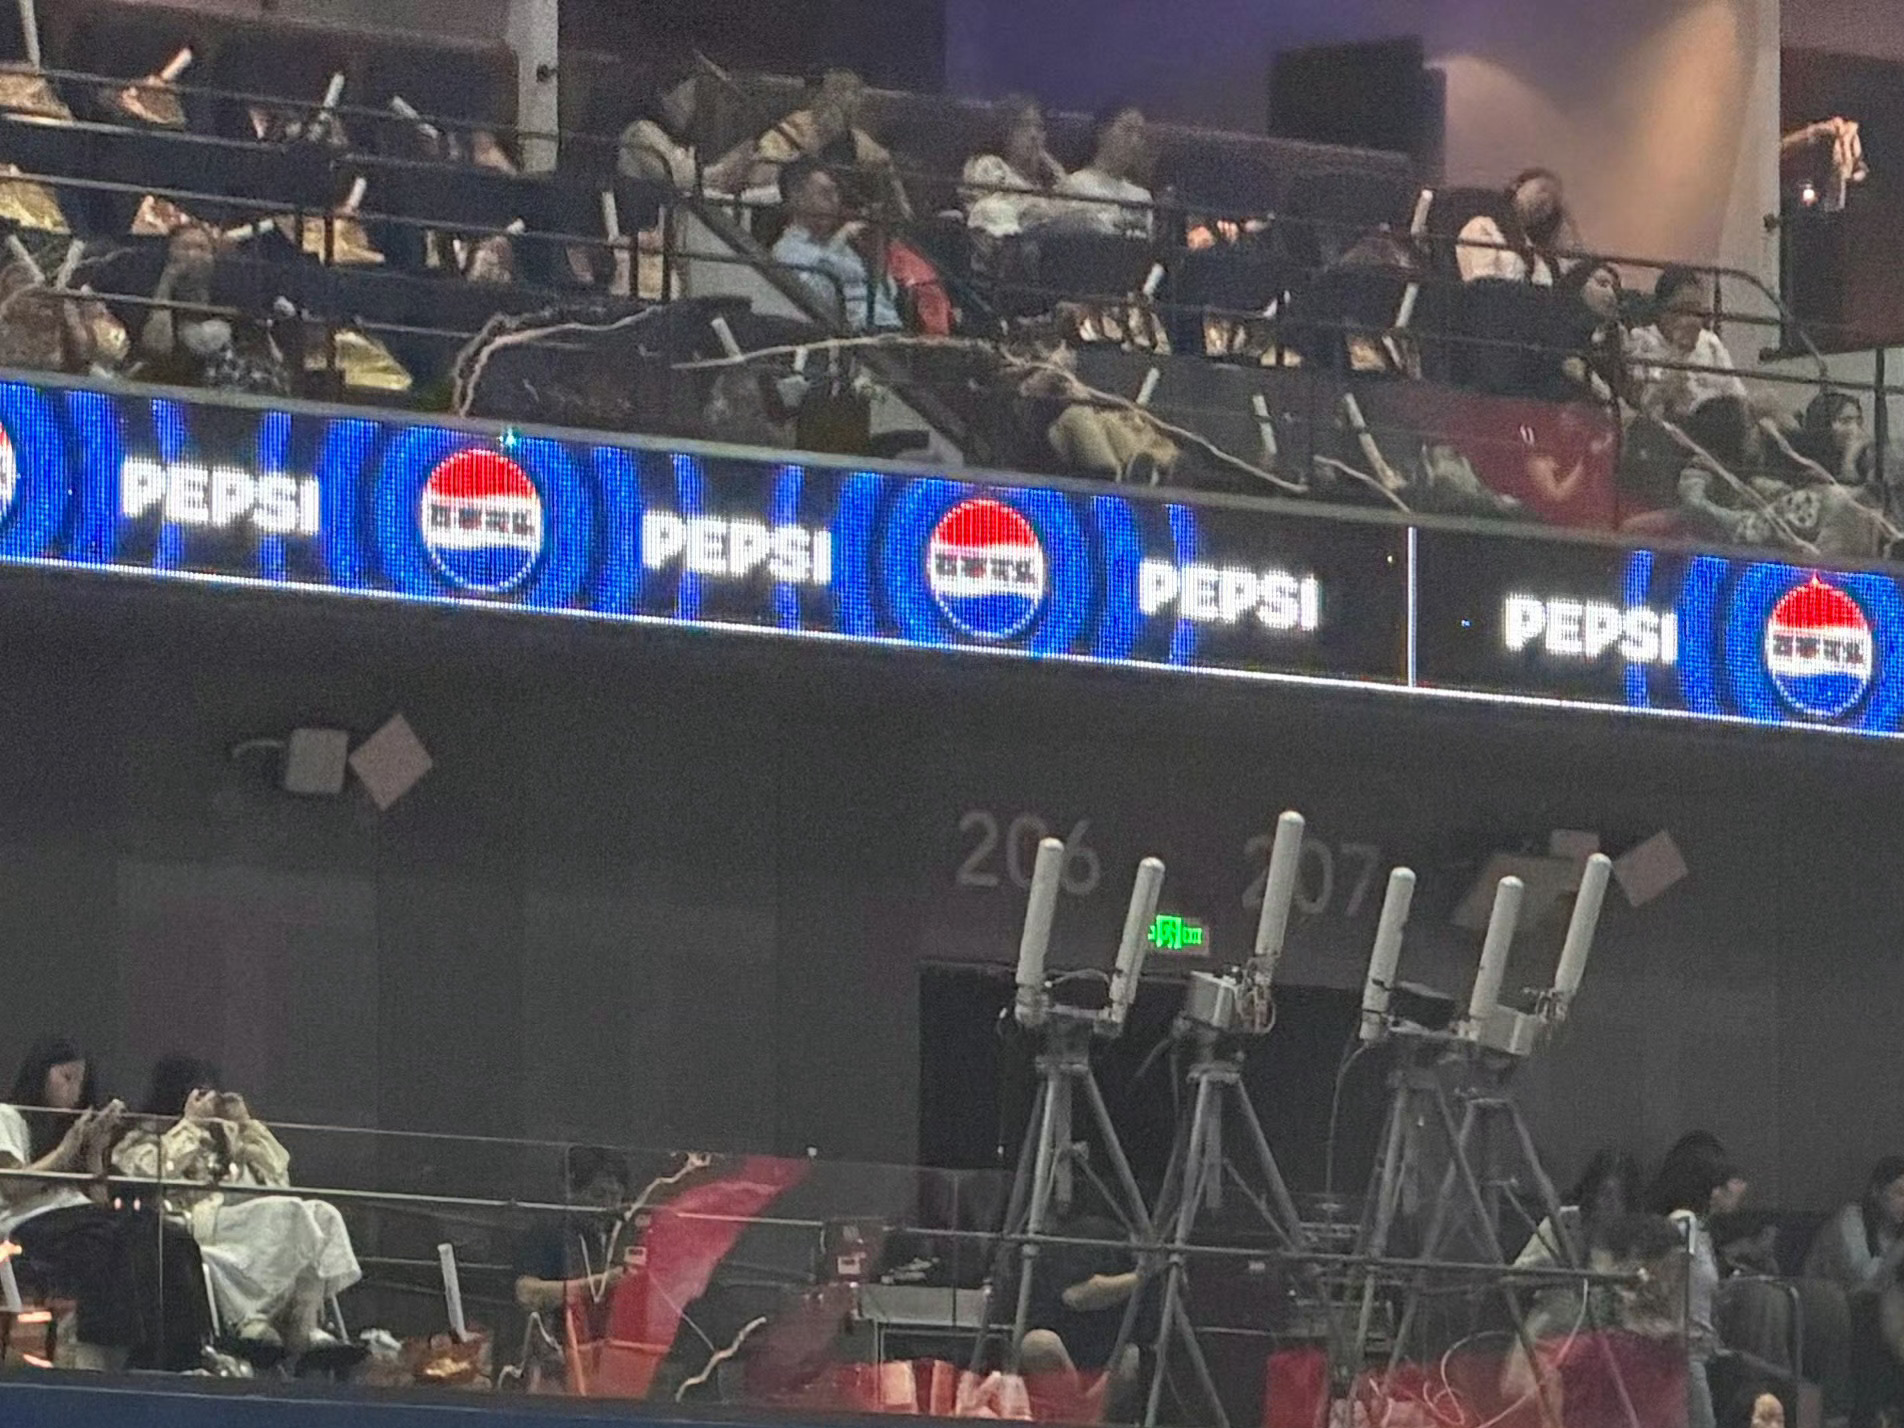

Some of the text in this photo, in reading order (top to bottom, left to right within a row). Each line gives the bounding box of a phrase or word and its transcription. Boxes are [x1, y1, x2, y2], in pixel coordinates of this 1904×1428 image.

[121, 457, 319, 535] PEPSI
[643, 510, 831, 585] PEPSI
[1139, 558, 1319, 631] PEPSI
[1503, 593, 1677, 665] PEPSI
[954, 811, 1101, 895] 206
